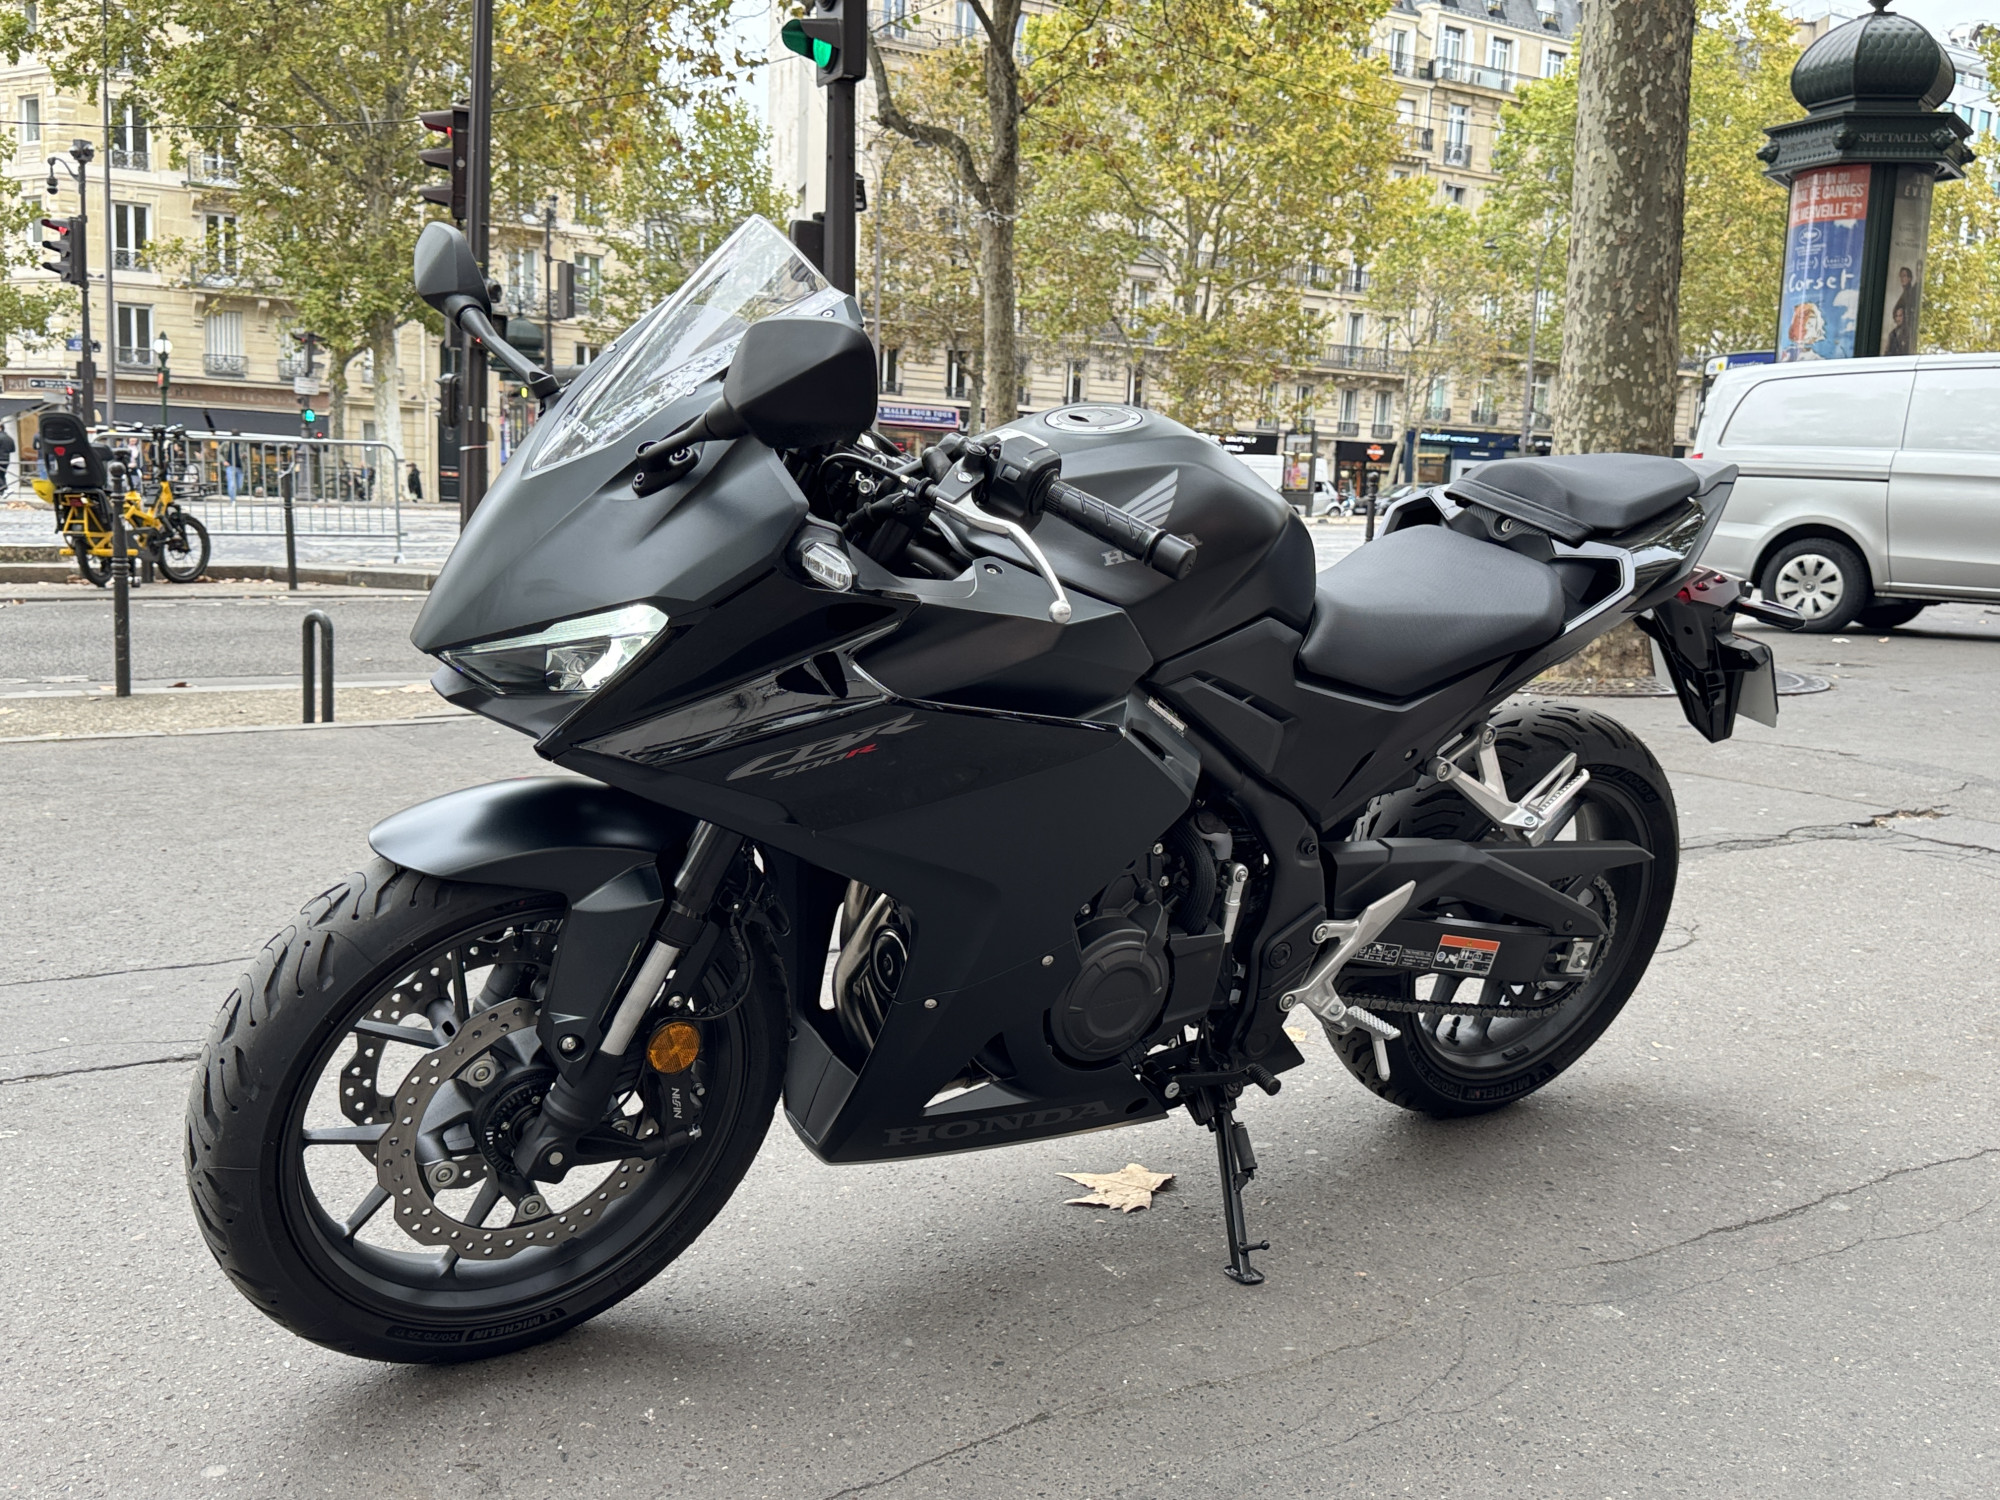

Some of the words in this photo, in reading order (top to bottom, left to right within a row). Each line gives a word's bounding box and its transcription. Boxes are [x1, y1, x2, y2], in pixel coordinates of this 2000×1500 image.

[1858, 132, 1929, 143] SPECTACLES
[1822, 183, 1864, 199] CANNES
[912, 409, 931, 417] POUR
[933, 410, 953, 418] TOUS
[1466, 1076, 1531, 1099] MICHELIN
[882, 1100, 1115, 1147] HONDA
[472, 1316, 541, 1339] MICHELIN
[423, 1331, 460, 1342] 120/70
